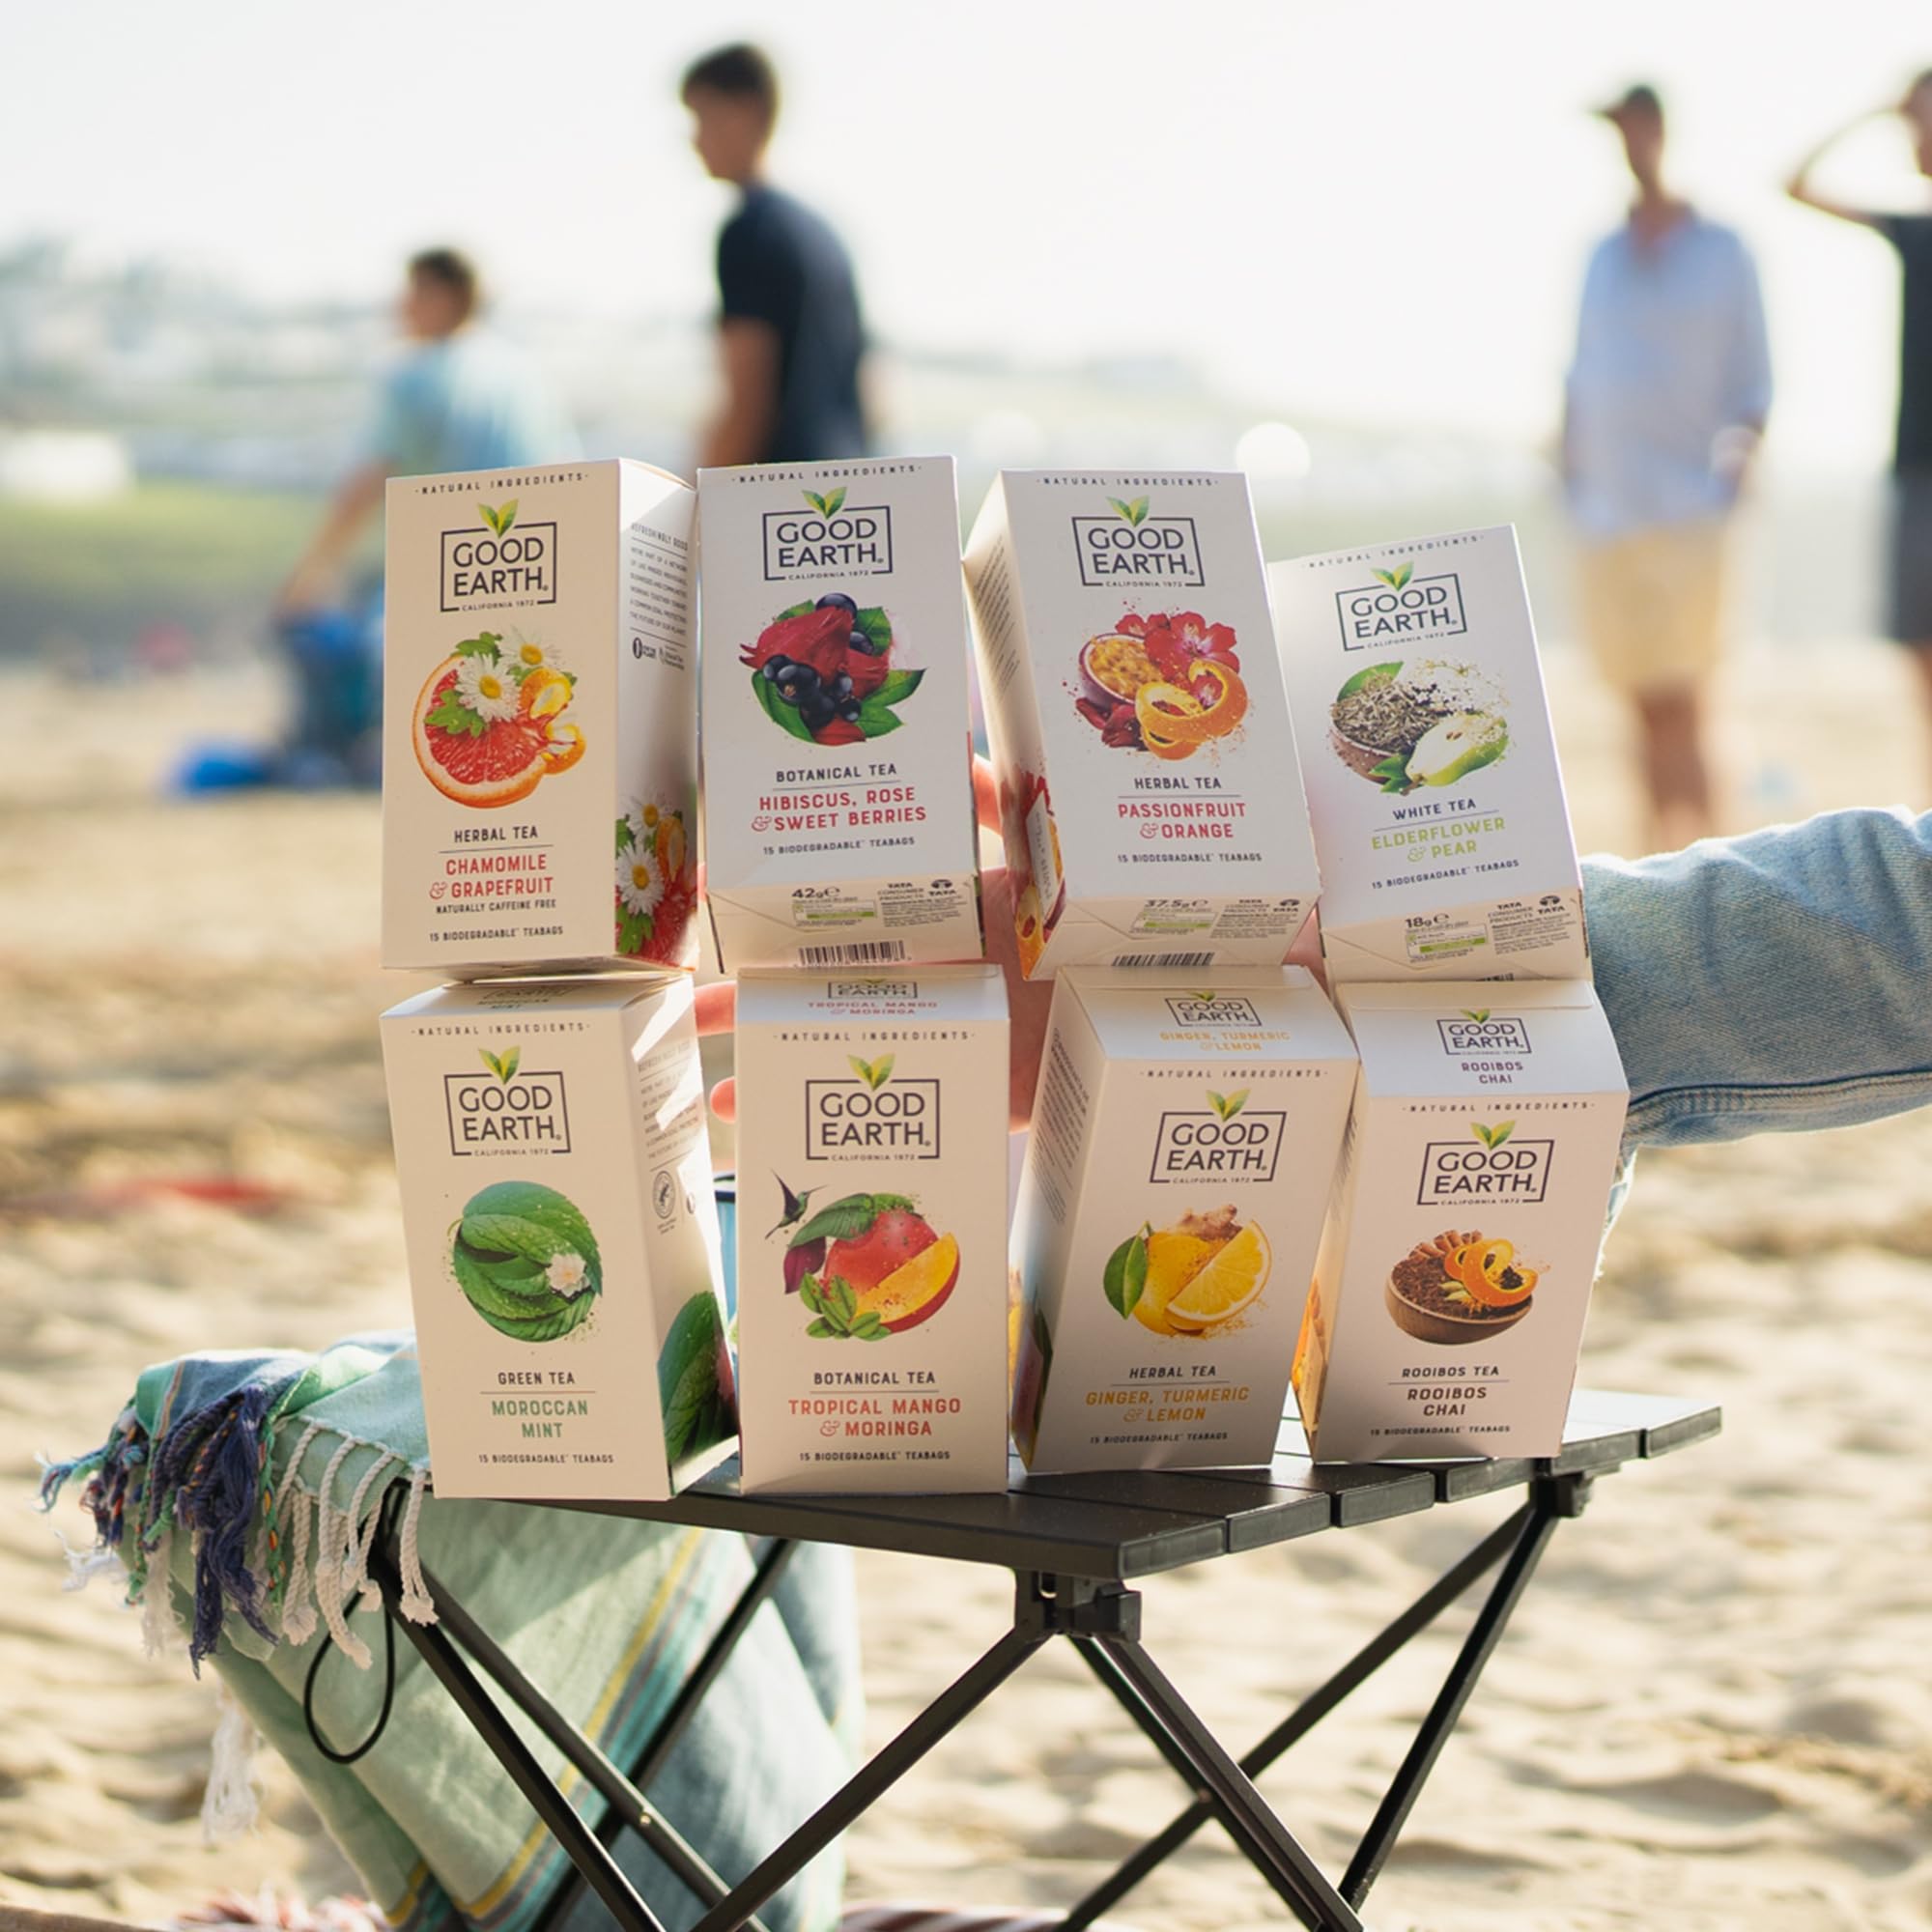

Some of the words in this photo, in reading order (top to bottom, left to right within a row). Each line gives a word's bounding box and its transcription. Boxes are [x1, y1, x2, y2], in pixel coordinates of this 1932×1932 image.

[777, 518, 877, 544] GOOD
[1088, 527, 1184, 550] GOOD
[453, 537, 544, 568] GOOD
[462, 601, 513, 611] CALIFORNIA
[1350, 585, 1447, 617] GOOD
[1368, 636, 1422, 649] CALIFORNIA
[777, 767, 861, 782] BOTANICAL
[868, 763, 896, 776] TEA
[1134, 778, 1189, 789] HERBAL
[1195, 778, 1222, 789] TEA
[759, 792, 857, 810] HIBISCUS,
[867, 786, 916, 804] ROSE
[1118, 803, 1245, 818] PASSIONFRUIT
[1393, 803, 1441, 820] WHITE
[1449, 799, 1476, 812] TEA
[752, 816, 772, 832] &
[774, 812, 839, 832] SWEET
[848, 807, 926, 826] BERRIES
[454, 827, 506, 842] HERBAL
[513, 826, 538, 838] TEA
[1140, 823, 1159, 838] &
[1161, 823, 1234, 838] ORANGE
[1372, 818, 1506, 850] ELDERFLOWER
[763, 846, 774, 856] 15
[869, 837, 915, 847] TEABAGS
[1407, 846, 1426, 862] &
[1432, 840, 1477, 858] PEAR
[446, 854, 547, 875] CHAMOMILE
[1118, 854, 1128, 863] 15
[1219, 853, 1262, 862] TEABAGS
[1475, 860, 1520, 873] TEABAGS
[430, 882, 447, 899] &
[451, 877, 554, 898] GRAPEFRUIT
[437, 903, 485, 914] NATURALLY
[489, 900, 530, 911] CAFFEINE
[535, 898, 556, 908] FREE
[430, 933, 439, 942] 15
[524, 926, 563, 936] TEABAGS
[1178, 1002, 1242, 1011] GOOD
[1448, 1023, 1516, 1036] GOOD
[1216, 1042, 1263, 1051] LEMON
[1462, 1062, 1523, 1071] ROOIBOS
[1479, 1074, 1513, 1084] CHAI
[459, 1086, 553, 1112] GOOD
[820, 1093, 925, 1118] GOOD
[1171, 1122, 1269, 1145] GOOD
[1437, 1151, 1537, 1172] GOOD
[498, 1372, 542, 1385] GREEN
[549, 1372, 575, 1384] TEA
[814, 1372, 899, 1385] BOTANICAL
[907, 1372, 935, 1383] TEA
[1129, 1367, 1183, 1378] HERBAL
[1191, 1366, 1216, 1377] TEA
[1402, 1367, 1466, 1378] ROOIBOS
[1473, 1366, 1499, 1376] TEA
[1086, 1391, 1154, 1406] GINGER,
[1163, 1387, 1250, 1403] TURMERIC
[1407, 1387, 1487, 1401] ROOIBOS
[492, 1400, 588, 1416] MOROCCAN
[788, 1400, 882, 1415] TROPICAL
[893, 1398, 960, 1414] MANGO
[1424, 1404, 1465, 1416] CHAI
[1122, 1408, 1144, 1423] &
[1147, 1408, 1206, 1422] LEMON
[522, 1423, 563, 1438] MINT
[820, 1420, 839, 1436] &
[845, 1421, 932, 1436] MORINGA
[479, 1455, 489, 1463] 15
[573, 1455, 614, 1463] TEABAGS
[800, 1453, 810, 1462] 15
[906, 1451, 950, 1460] TEABAGS
